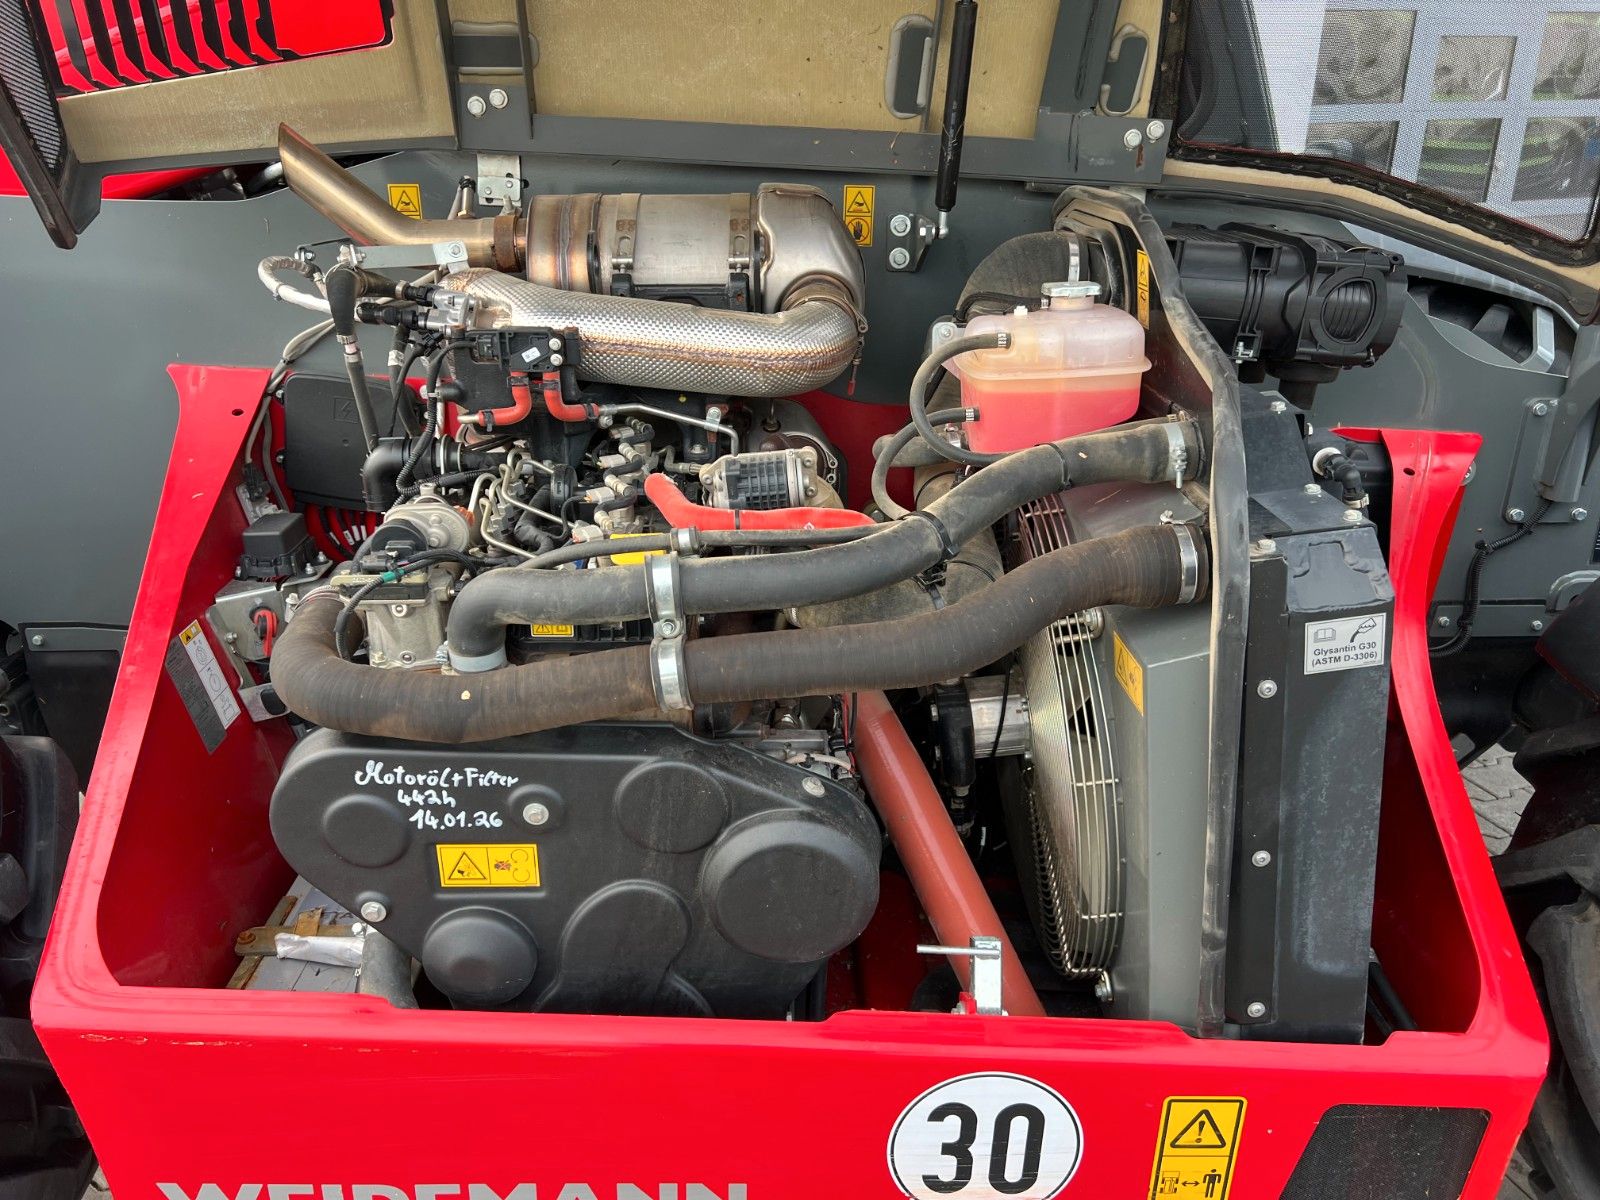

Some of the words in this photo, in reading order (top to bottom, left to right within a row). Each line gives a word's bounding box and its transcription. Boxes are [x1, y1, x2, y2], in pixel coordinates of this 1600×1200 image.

[1313, 644, 1356, 656] Glysantin
[1358, 641, 1377, 650] G30
[1311, 656, 1341, 668] (ASTM
[1344, 651, 1378, 662] D-3306)
[397, 789, 457, 808] 442h
[409, 808, 503, 830] 14.01.26
[921, 1102, 1046, 1195] 30
